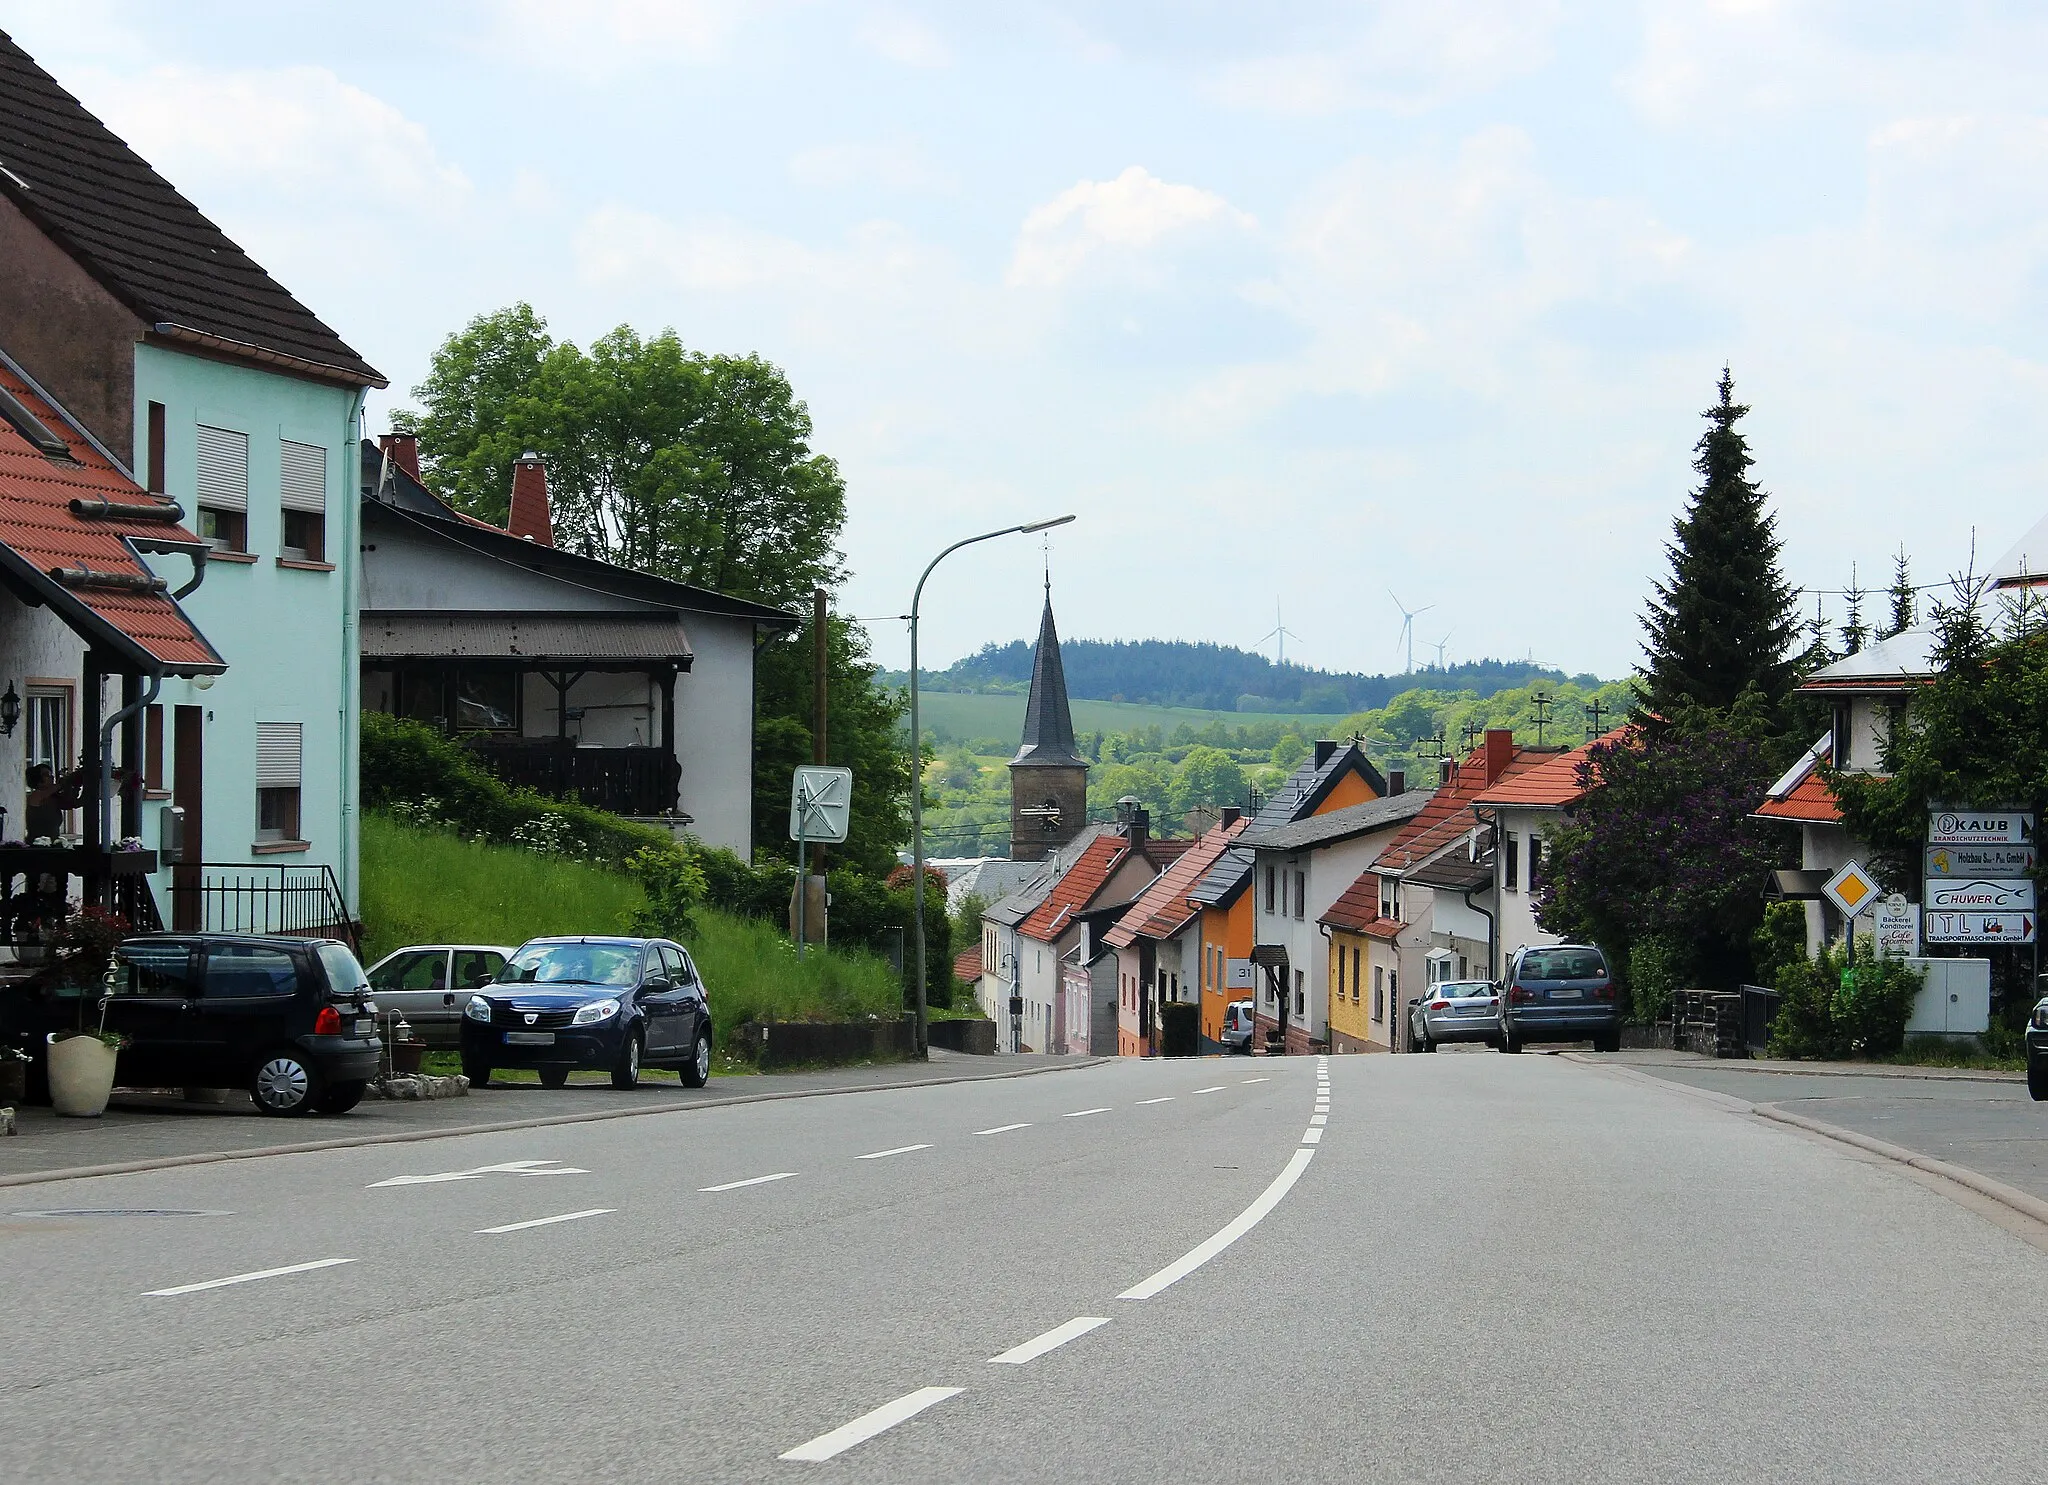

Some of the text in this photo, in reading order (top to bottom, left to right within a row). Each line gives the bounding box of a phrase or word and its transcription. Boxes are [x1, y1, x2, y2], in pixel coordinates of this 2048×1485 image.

[1957, 820, 2008, 831] KAUB
[1958, 852, 1982, 863] Holzbau
[2006, 852, 2025, 863] GmbH
[1238, 968, 1250, 977] 31
